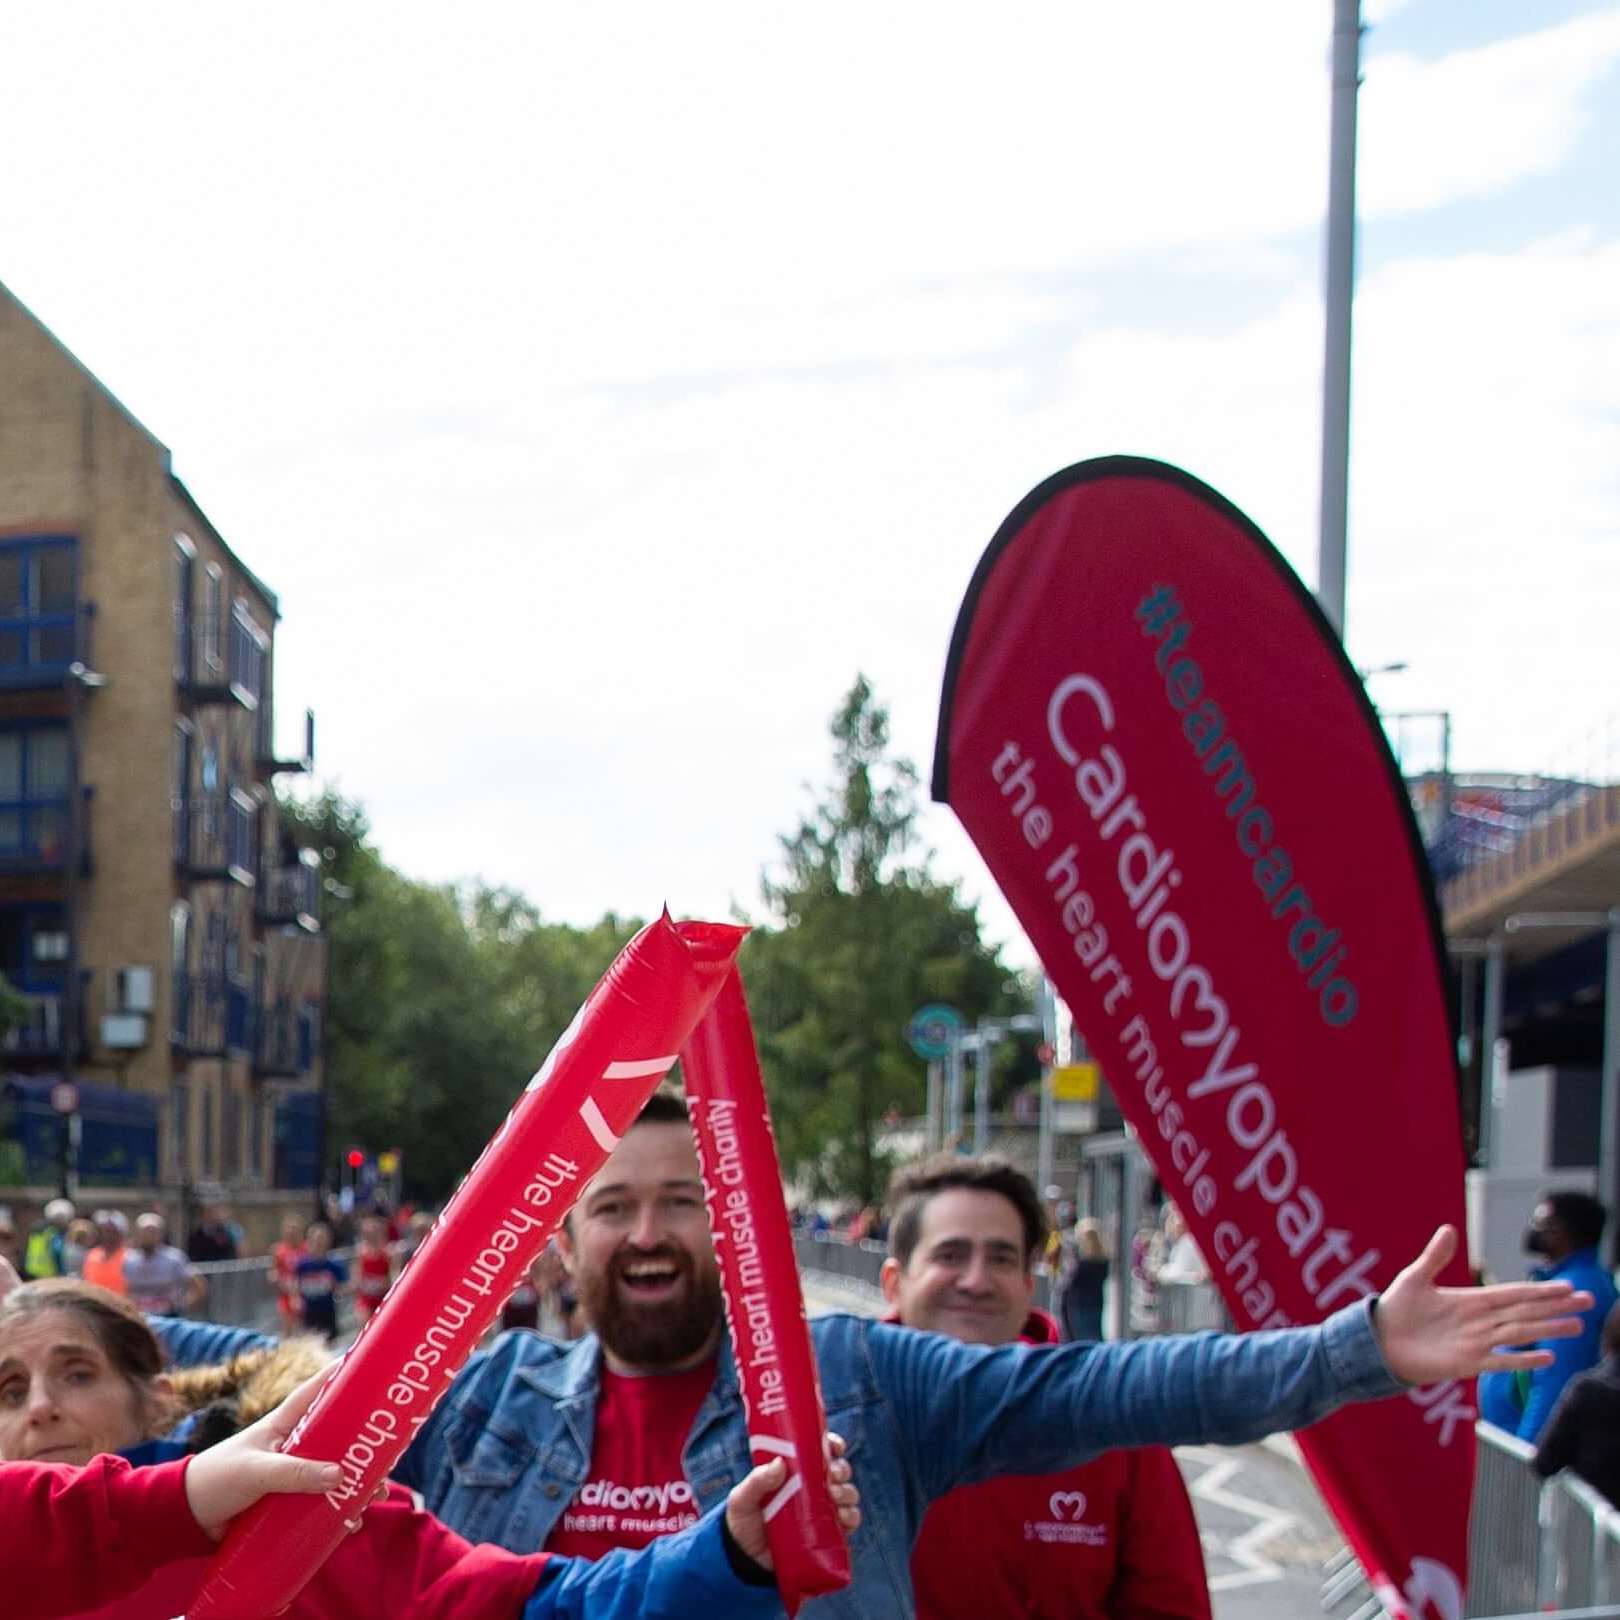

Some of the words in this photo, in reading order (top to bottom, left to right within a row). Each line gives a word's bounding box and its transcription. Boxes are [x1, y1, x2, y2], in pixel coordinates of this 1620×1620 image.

[1134, 583, 1358, 1027] #teamcardio
[992, 740, 1054, 850] the
[1046, 843, 1133, 1017] heart
[1119, 1013, 1218, 1218] muscle
[1046, 672, 1382, 1311] Cardiomyopath
[522, 1152, 580, 1208] the
[705, 1097, 745, 1187] charity
[461, 1207, 544, 1298] heart
[721, 1188, 764, 1289] muscle
[385, 1292, 477, 1407] muscle
[742, 1291, 779, 1367] heart
[755, 1369, 787, 1417] the
[324, 1407, 398, 1512] charity
[563, 1512, 617, 1533] heart
